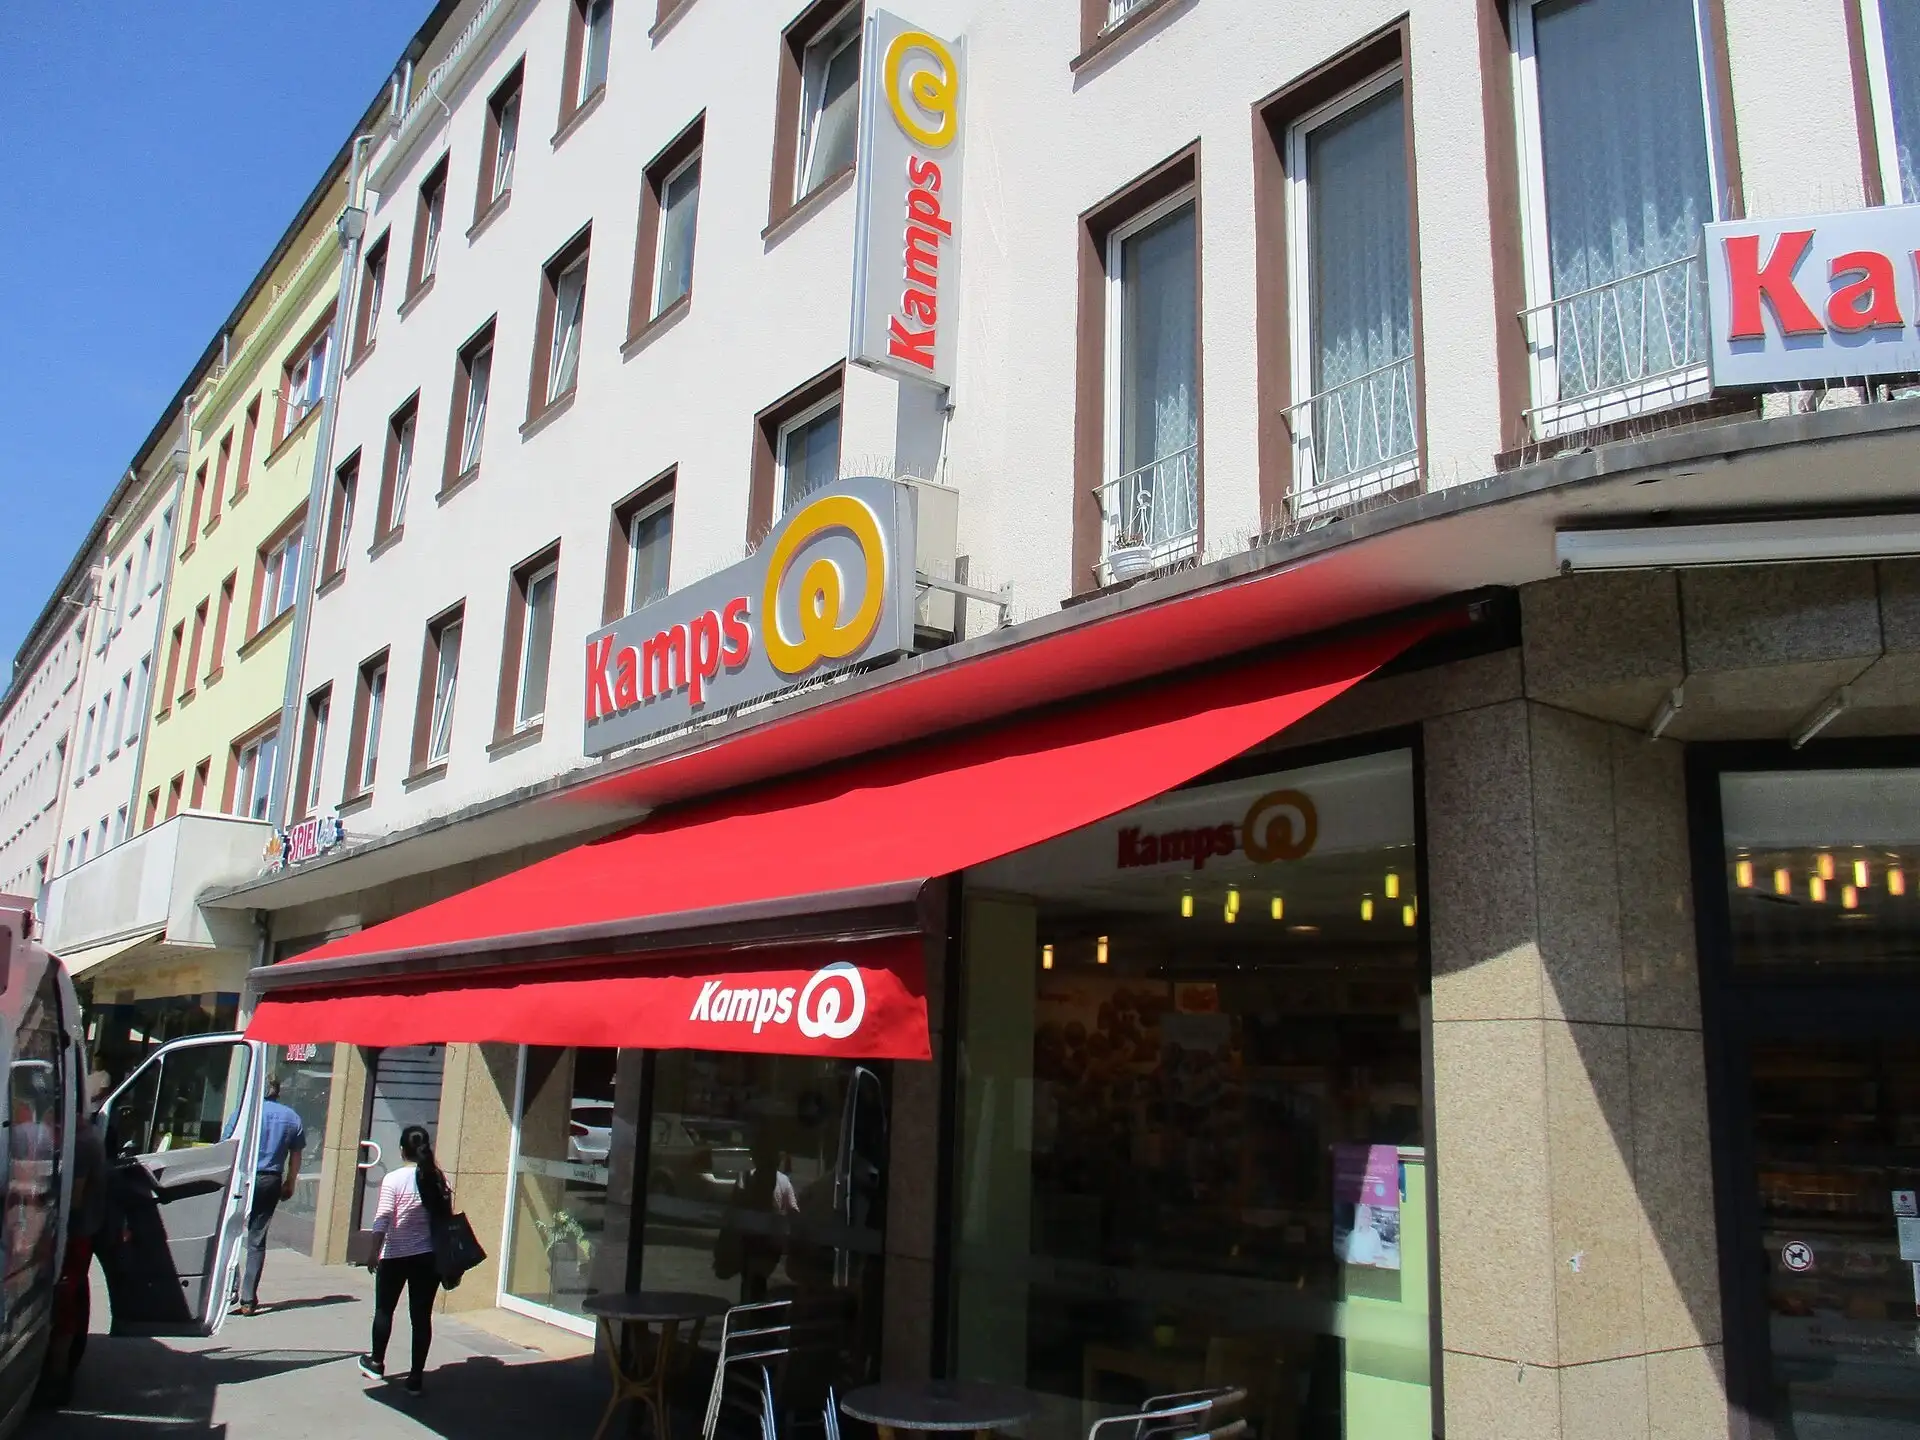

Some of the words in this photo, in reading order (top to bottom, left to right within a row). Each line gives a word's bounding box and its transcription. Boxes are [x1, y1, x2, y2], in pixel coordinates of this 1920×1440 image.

[885, 154, 952, 371] Kamps
[1720, 228, 1919, 342] Ka
[585, 595, 754, 722] Kamps
[288, 820, 318, 864] SPIEL
[1118, 823, 1236, 870] Kamps
[690, 979, 797, 1033] Kamps
